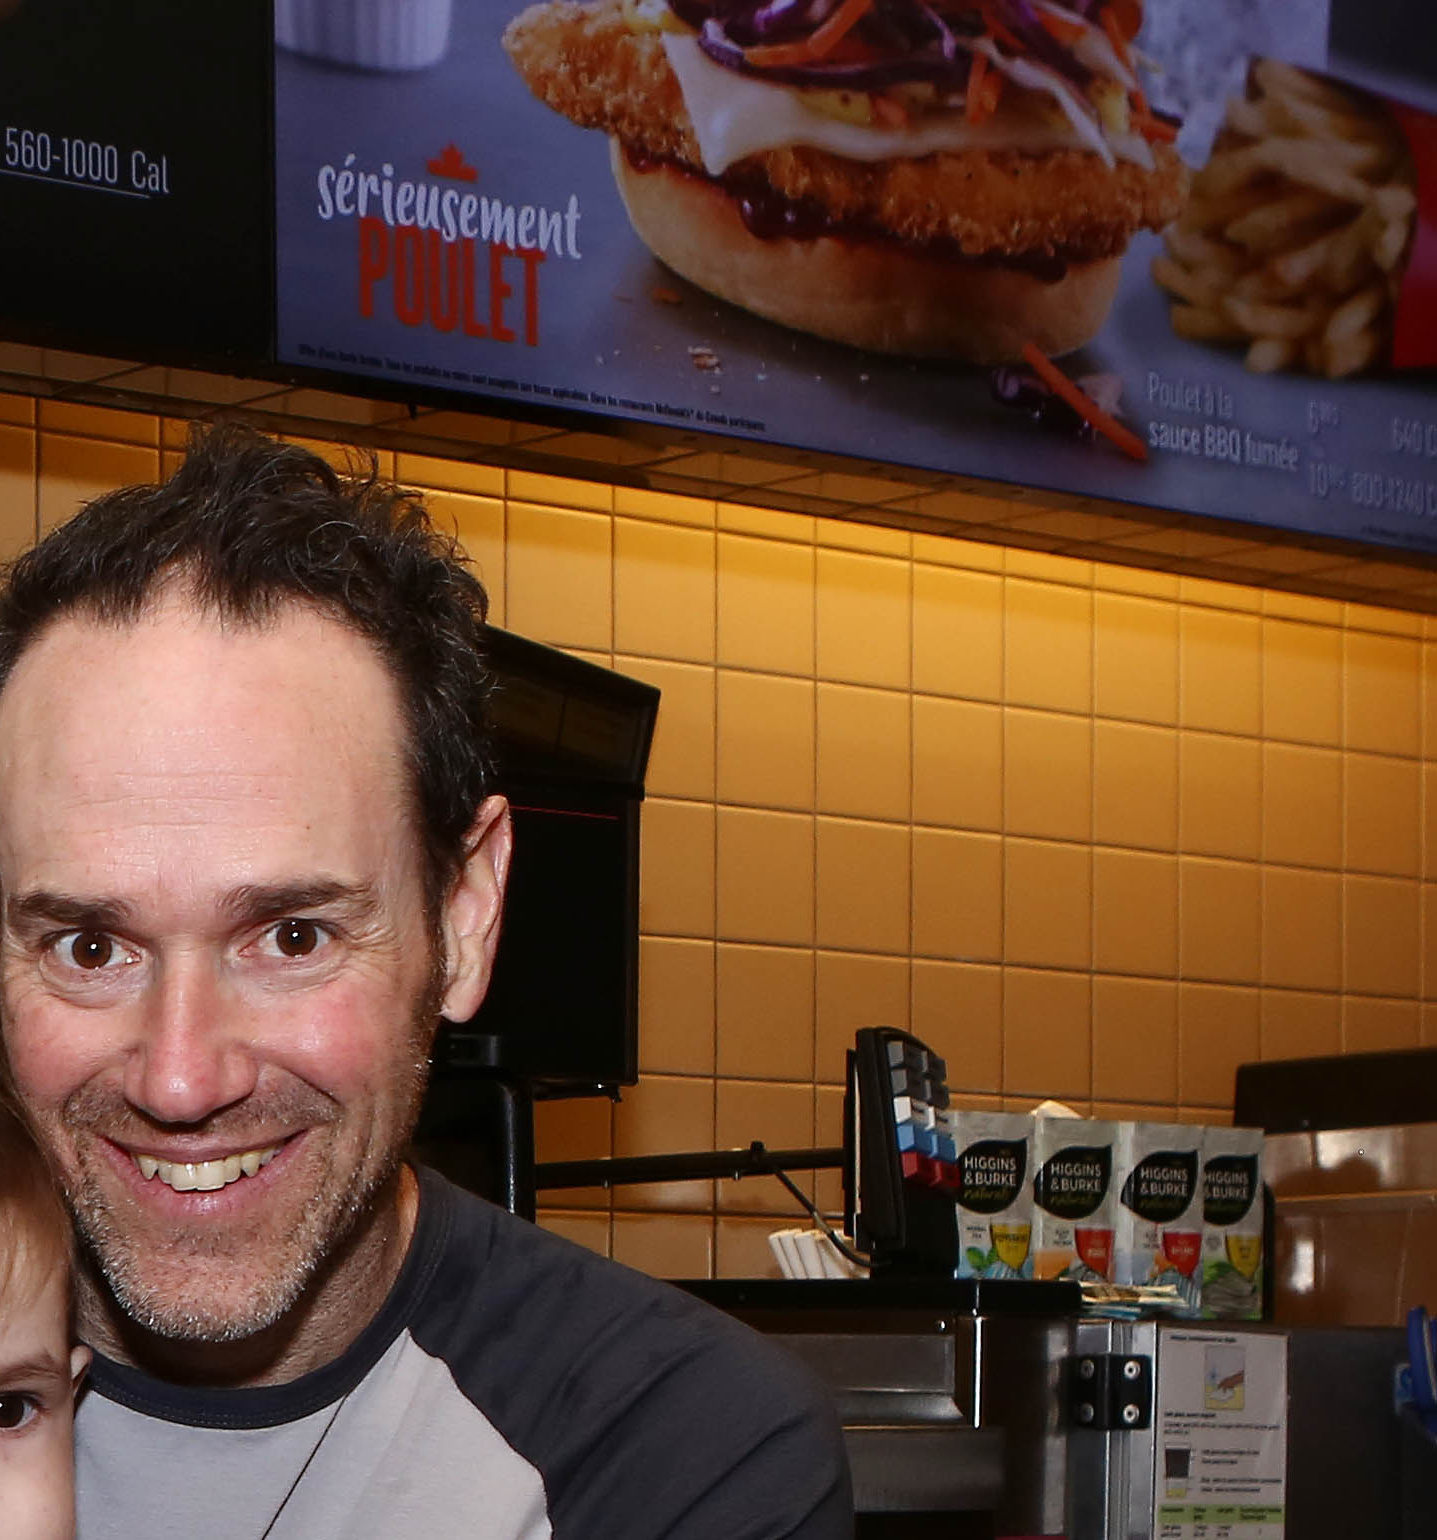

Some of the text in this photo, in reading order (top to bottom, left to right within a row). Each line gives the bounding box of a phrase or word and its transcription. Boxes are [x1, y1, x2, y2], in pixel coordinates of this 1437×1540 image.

[6, 127, 118, 183] 560-1000
[132, 151, 169, 193] Cal
[317, 154, 582, 260] sérieusement
[358, 217, 547, 348] POULET
[1149, 372, 1201, 415] Poulet
[1149, 423, 1299, 472] sauce BBQ fumée
[964, 1156, 1016, 1171] HIGGINS
[1050, 1163, 1102, 1176] HIGGINS
[964, 1171, 1016, 1186] & BURKE
[1140, 1167, 1188, 1181] HIGGINS
[1050, 1178, 1101, 1192] & BURKE
[1150, 1182, 1188, 1197] BURKE
[1213, 1186, 1247, 1198] BURKE
